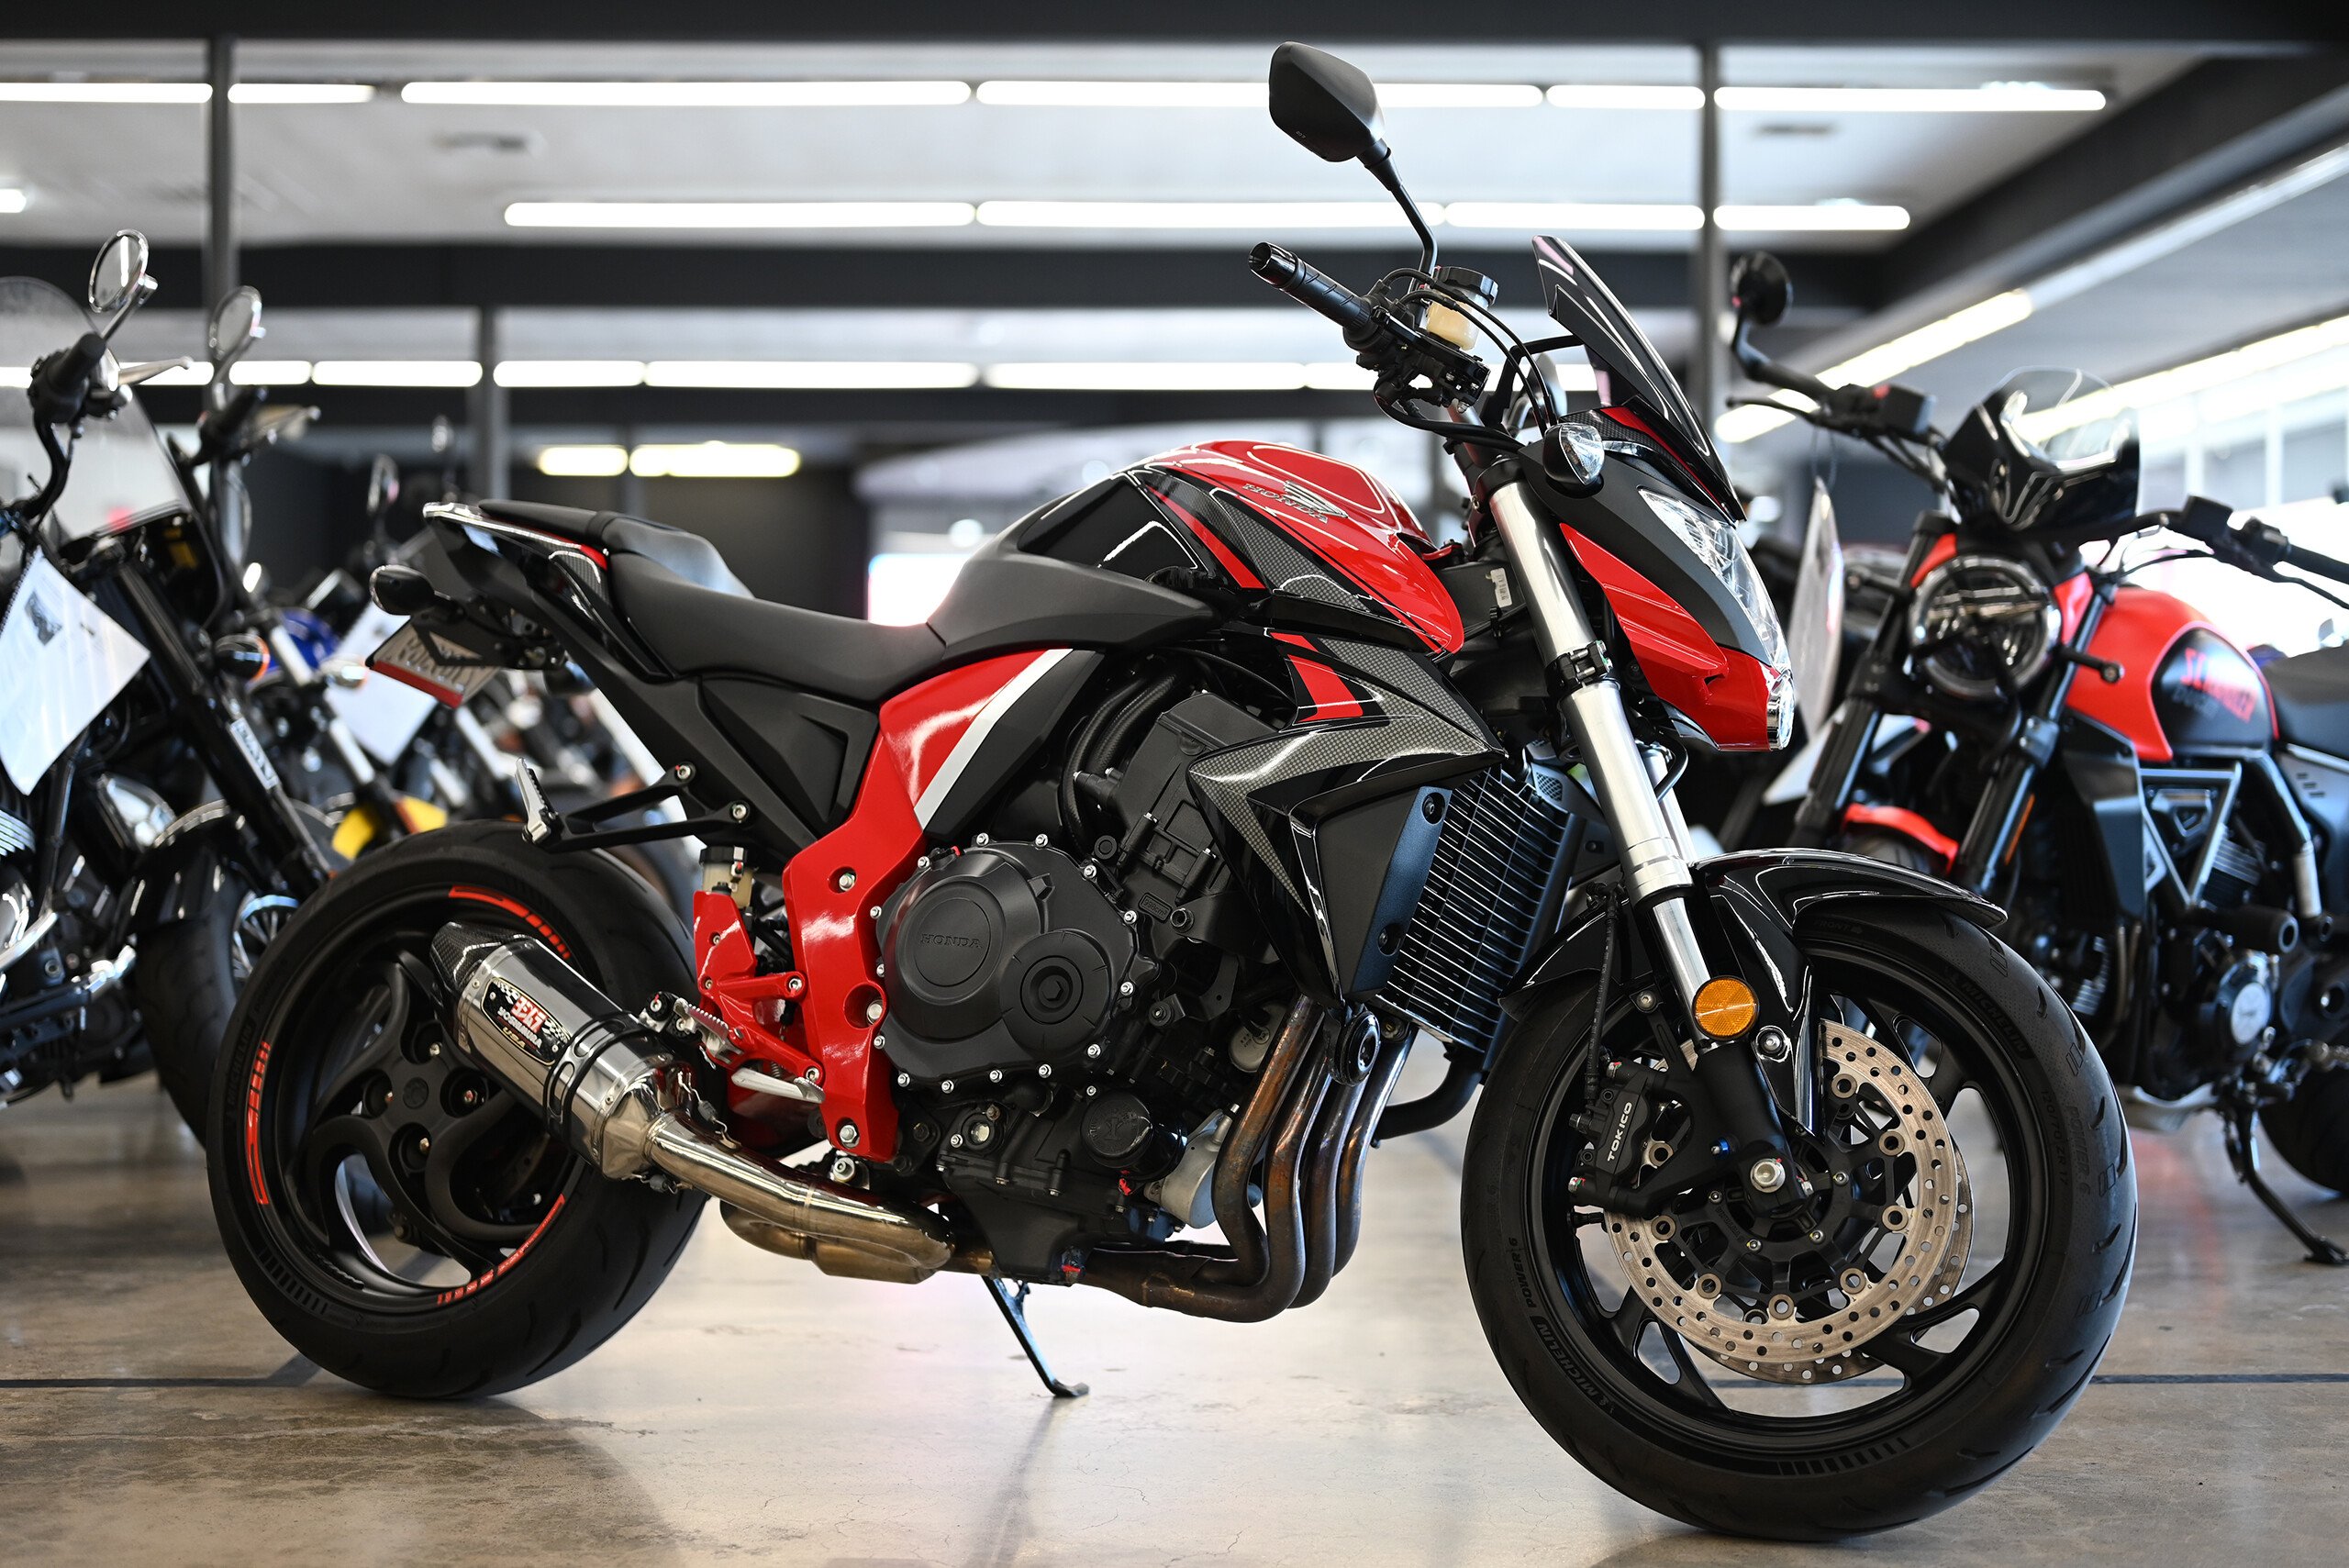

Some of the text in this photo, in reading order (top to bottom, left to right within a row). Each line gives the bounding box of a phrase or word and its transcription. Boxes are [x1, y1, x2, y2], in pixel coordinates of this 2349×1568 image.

[1242, 483, 1328, 524] HONDA
[919, 932, 983, 949] HONDA
[496, 1006, 543, 1049] YOSHIMURA
[502, 1026, 526, 1049] USA
[1961, 973, 2028, 1053] MICHELIN
[1607, 1101, 1633, 1162] TOKICO
[2065, 1105, 2090, 1176] POWER
[1510, 1251, 1538, 1308] POWER
[1536, 1322, 1599, 1398] MICHELIN
